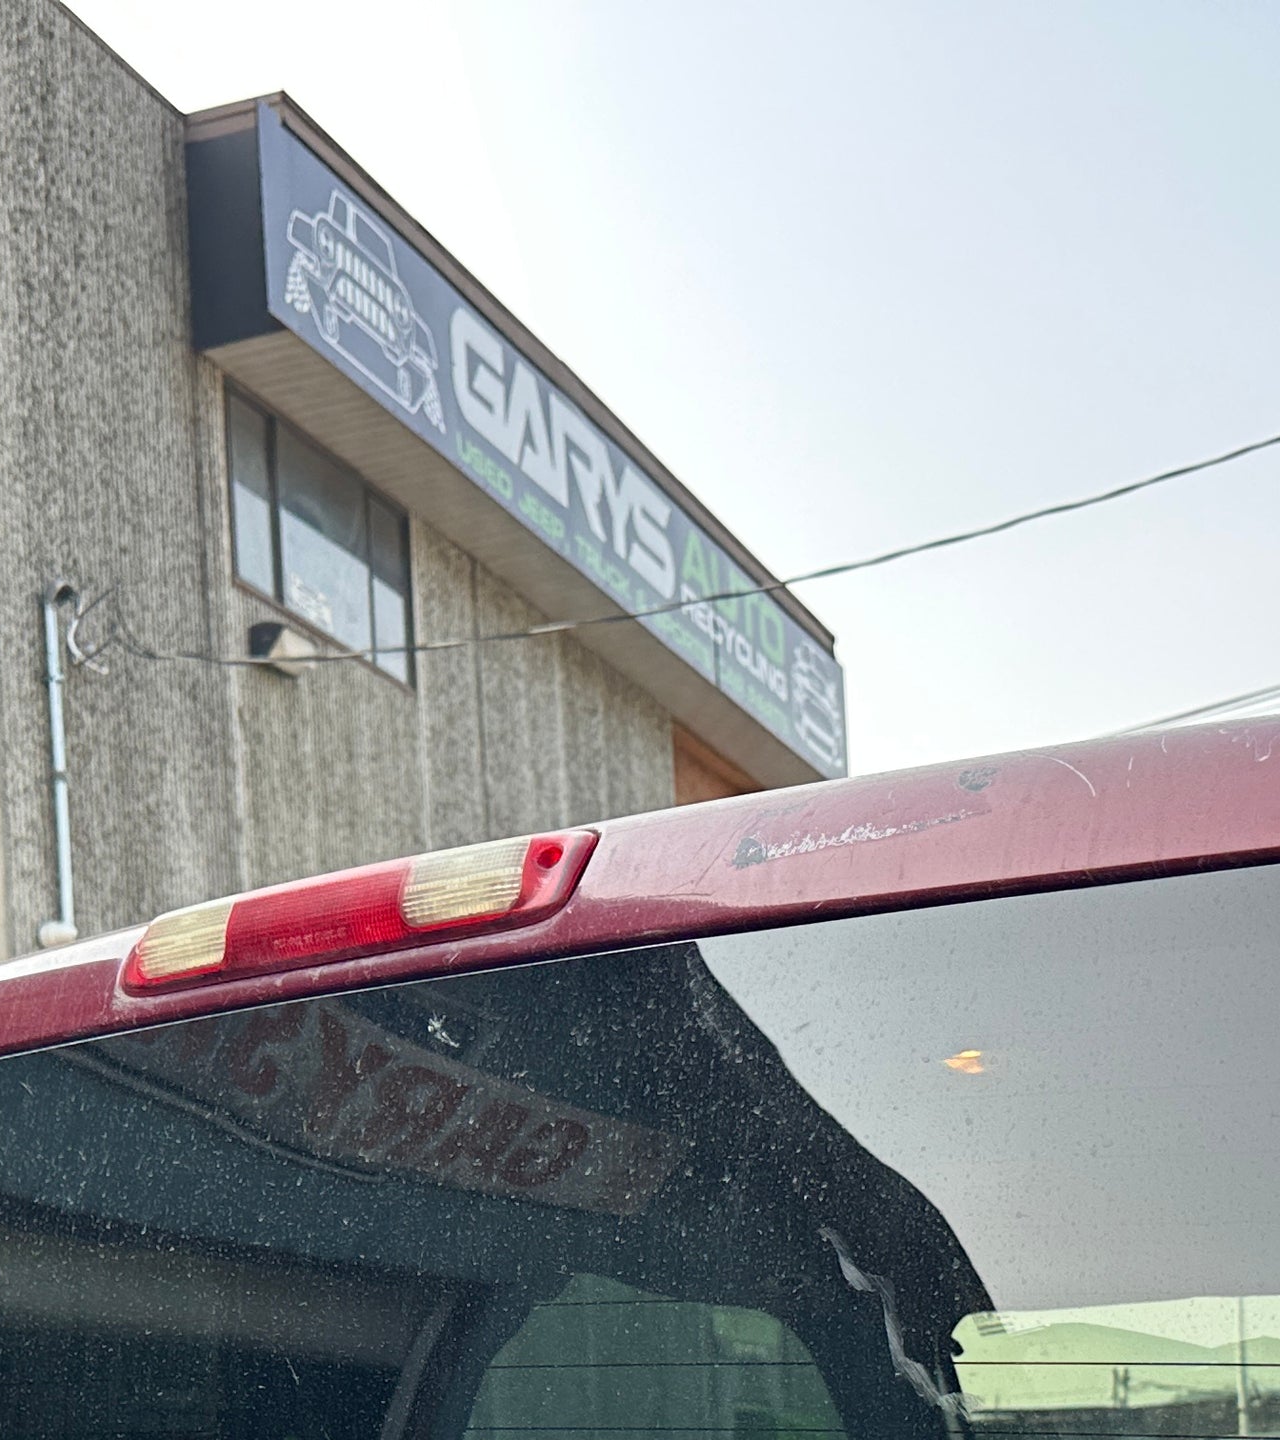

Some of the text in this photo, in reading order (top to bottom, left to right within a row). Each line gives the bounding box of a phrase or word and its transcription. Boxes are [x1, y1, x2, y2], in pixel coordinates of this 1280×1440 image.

[450, 307, 677, 600] GARYS
[680, 582, 789, 702] RECYCLING
[681, 528, 785, 668] AUTO
